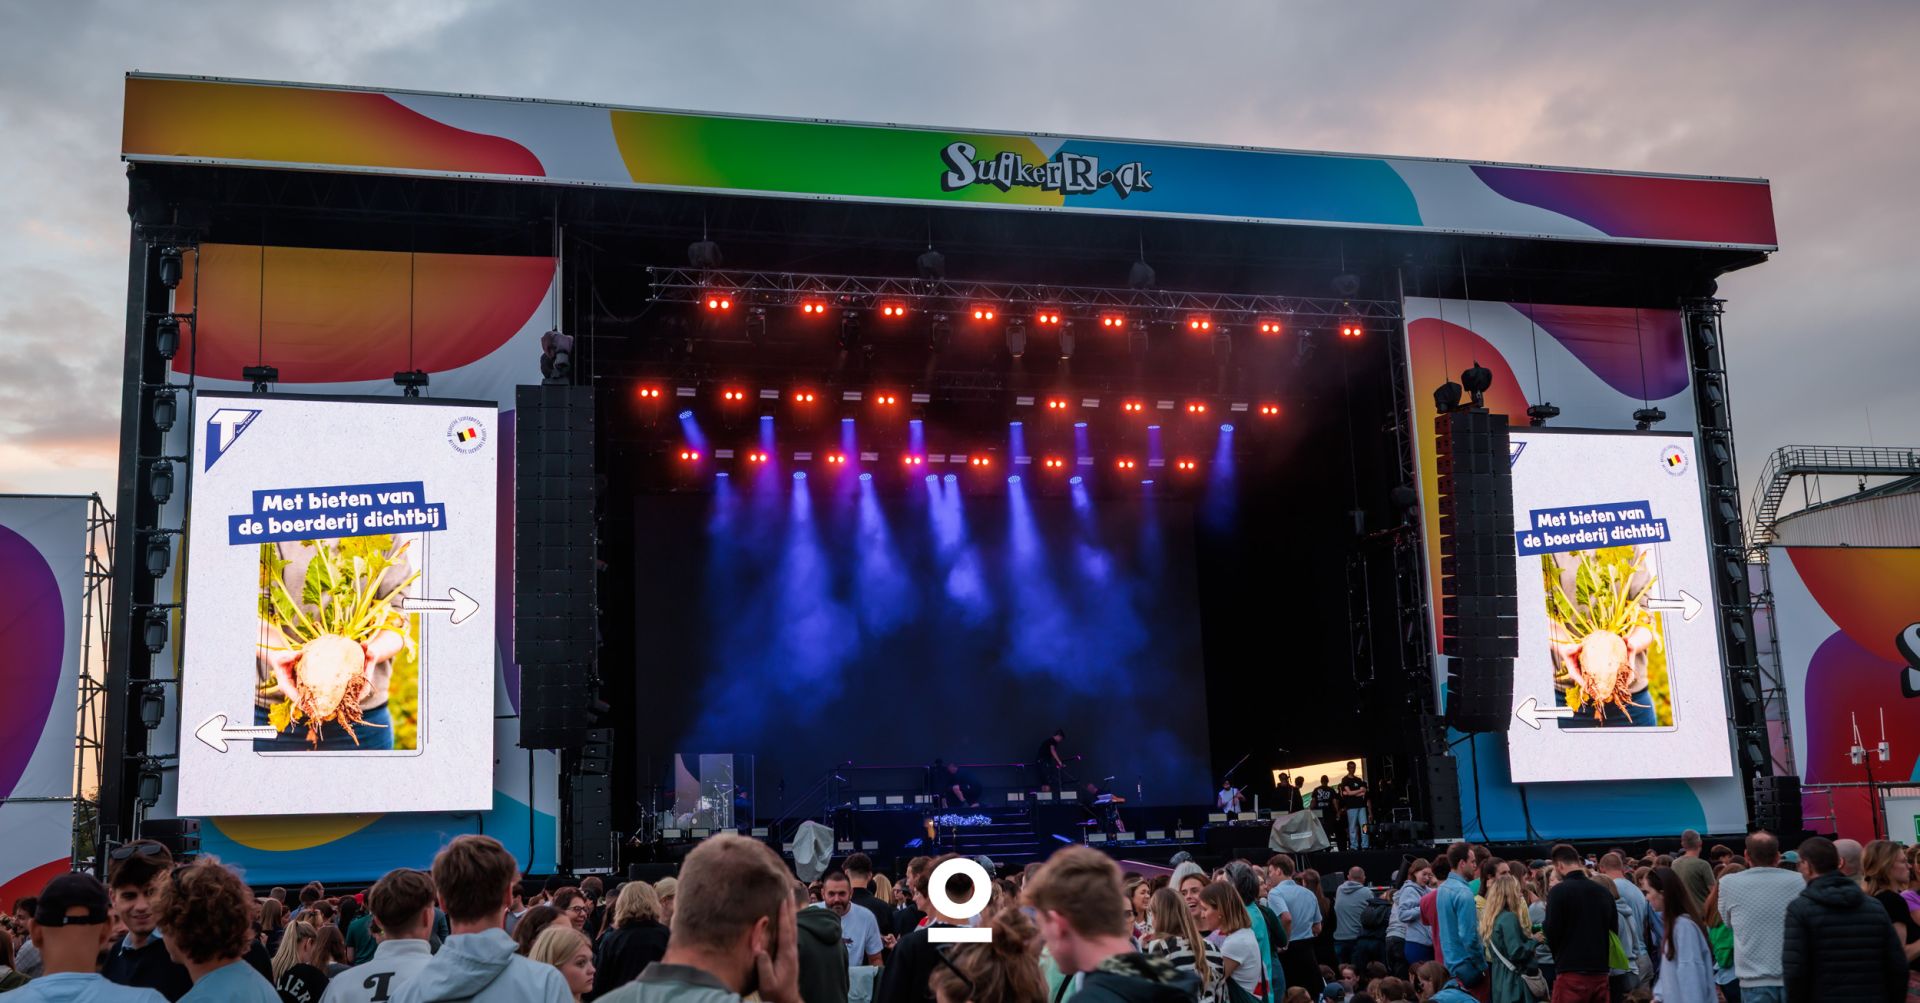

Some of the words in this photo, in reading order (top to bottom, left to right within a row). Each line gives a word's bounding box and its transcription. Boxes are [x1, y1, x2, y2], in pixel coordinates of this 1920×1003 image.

[940, 141, 1153, 199] SuikerRock
[262, 494, 303, 511] Met
[308, 491, 372, 510] bieten
[377, 490, 415, 505] van
[238, 519, 264, 535] de
[268, 512, 359, 534] boerderij
[363, 508, 439, 528] dichtbij
[1537, 512, 1566, 528] Met
[1569, 509, 1615, 525] bieten
[1617, 508, 1645, 521] van
[1523, 533, 1542, 548] de
[1543, 527, 1609, 547] boerderij
[1611, 522, 1665, 540] dichtbij
